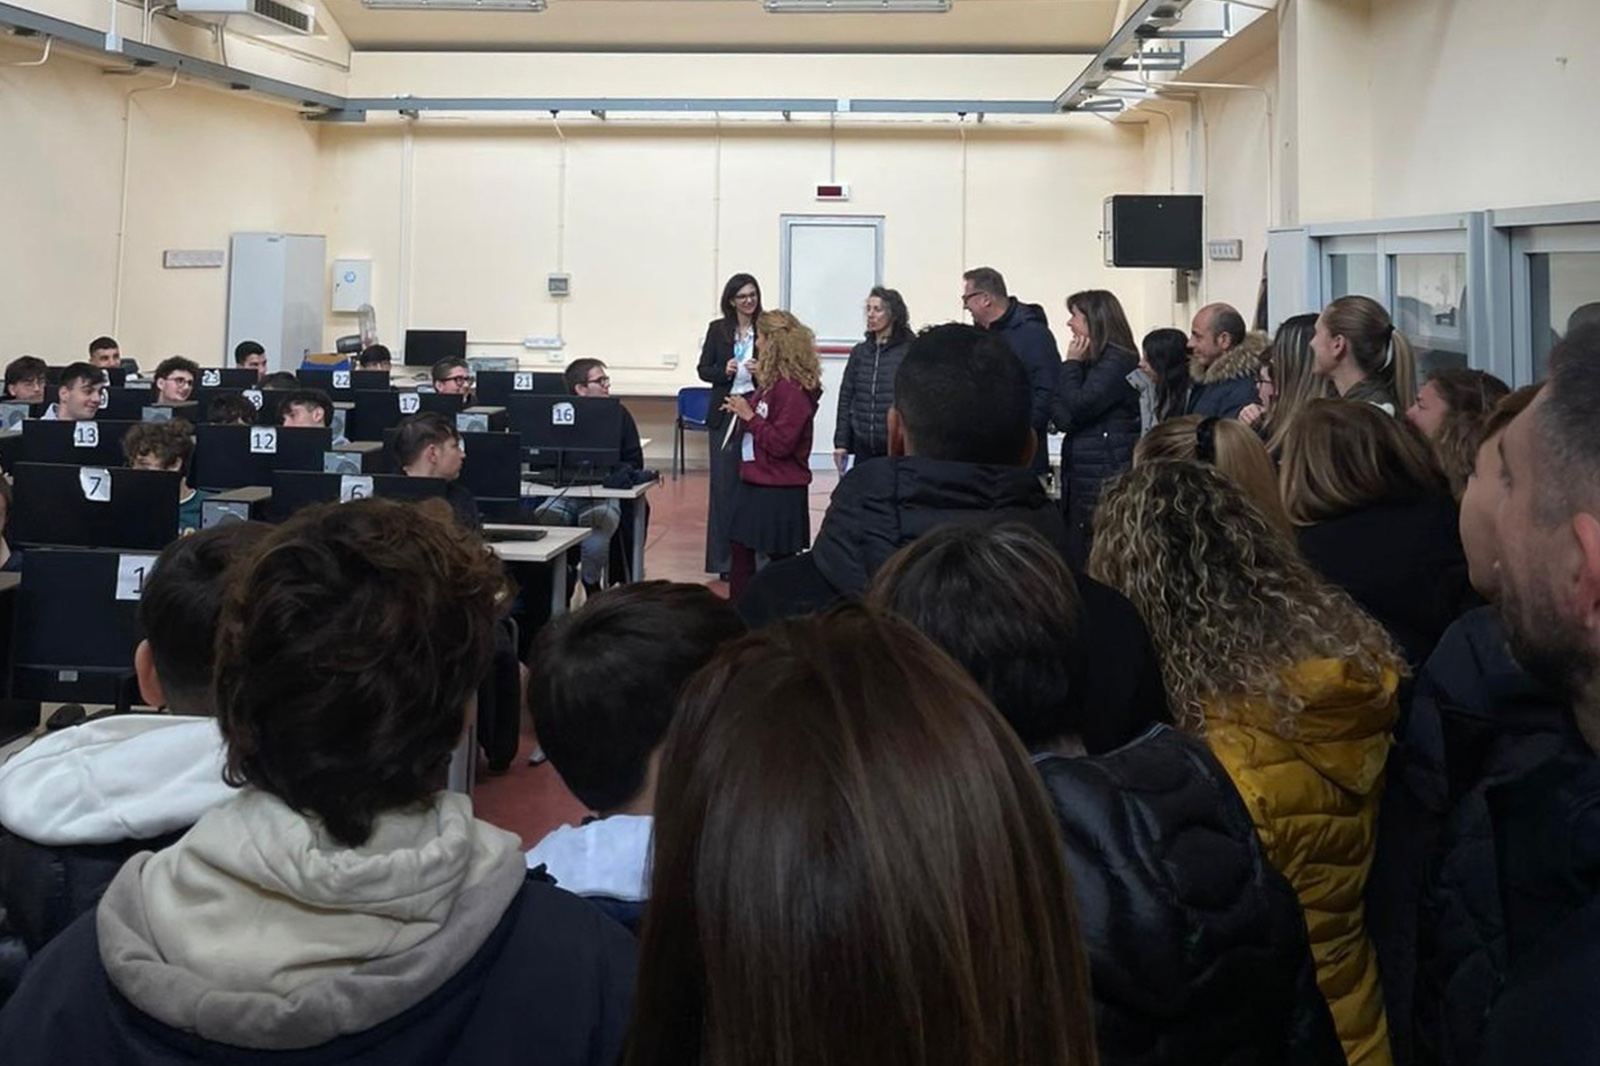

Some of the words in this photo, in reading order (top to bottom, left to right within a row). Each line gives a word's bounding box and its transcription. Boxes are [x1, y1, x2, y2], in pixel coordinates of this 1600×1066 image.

[204, 372, 219, 384] 23
[335, 374, 349, 386] 22
[516, 375, 530, 388] 21
[402, 398, 418, 411] 17
[556, 408, 572, 422] 16
[77, 428, 96, 443] 13
[253, 433, 274, 449] 12
[89, 476, 102, 496] 7
[351, 484, 364, 499] 6
